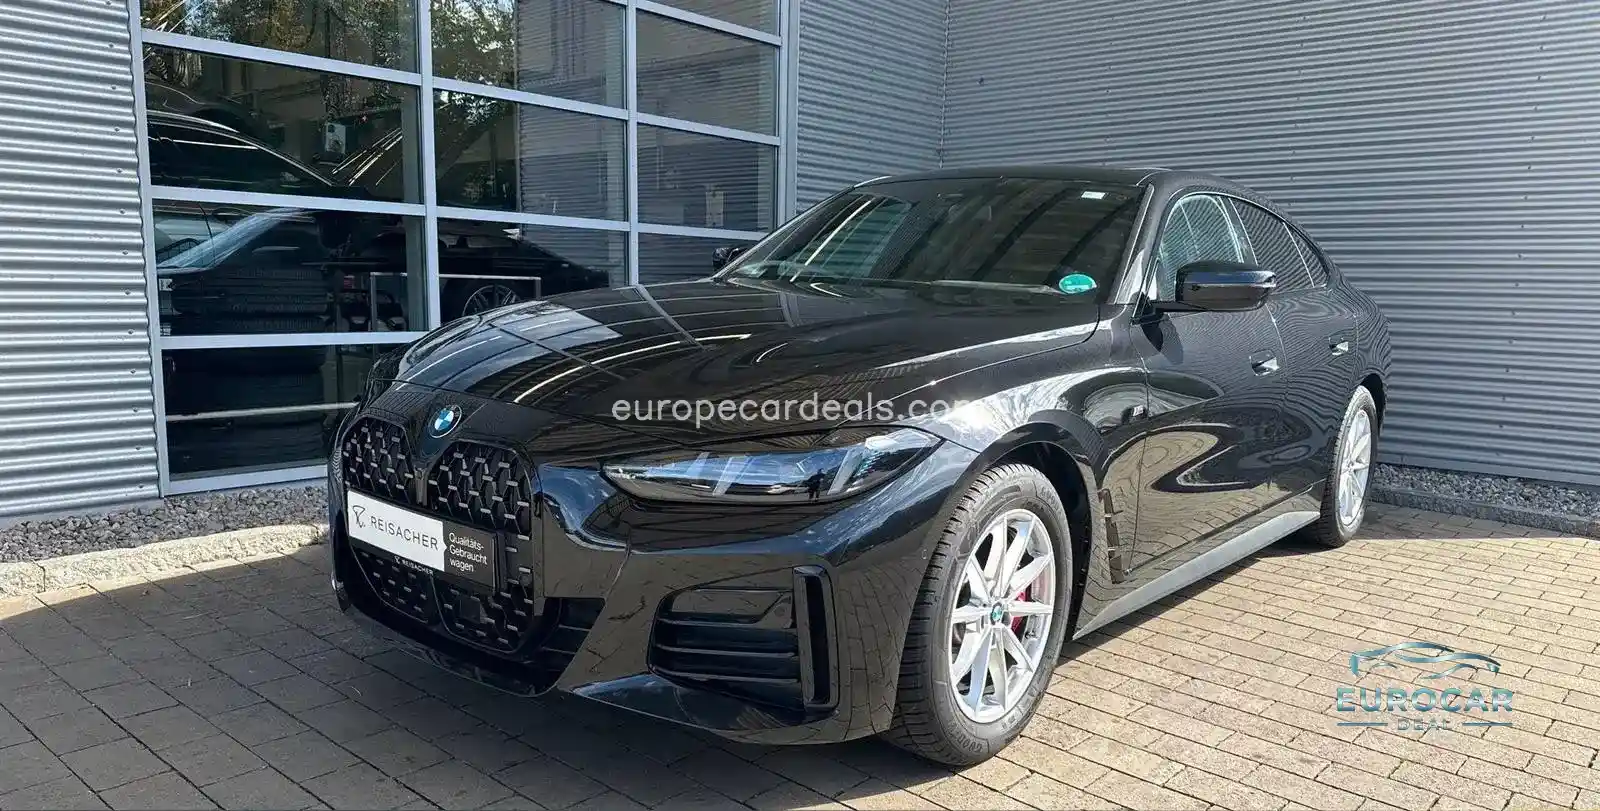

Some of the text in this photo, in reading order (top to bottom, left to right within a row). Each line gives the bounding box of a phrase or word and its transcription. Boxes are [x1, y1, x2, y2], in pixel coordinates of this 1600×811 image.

[370, 515, 439, 551] REISACHER
[448, 532, 485, 551] Qualitäts-
[449, 544, 488, 565] Gebraucht
[401, 558, 434, 577] REISACHER
[449, 558, 474, 573] wagen
